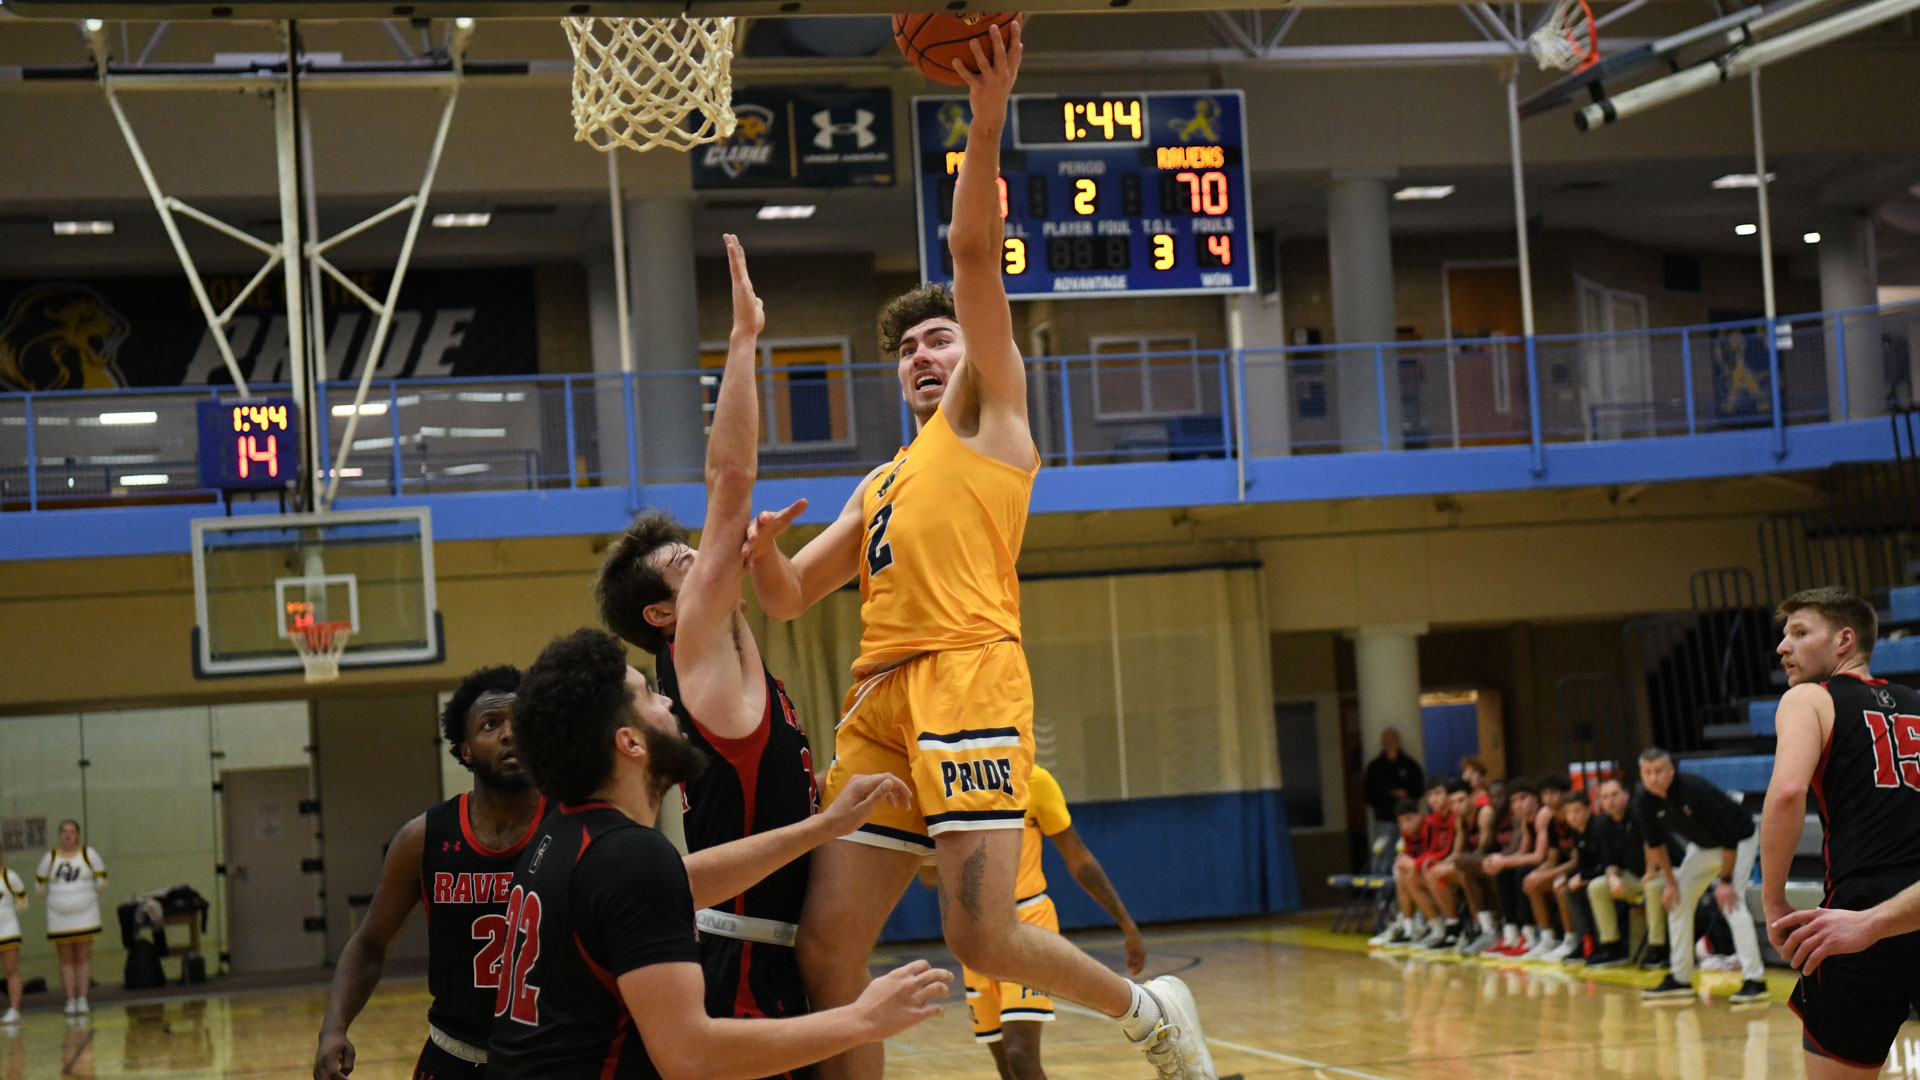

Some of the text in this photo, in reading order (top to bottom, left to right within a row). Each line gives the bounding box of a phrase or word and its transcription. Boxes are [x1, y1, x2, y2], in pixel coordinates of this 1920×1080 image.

[1064, 101, 1142, 140] 1:44
[1059, 161, 1105, 175] PERIOD
[1074, 178, 1097, 215] 2
[1176, 172, 1229, 215] 70
[1043, 219, 1131, 237] PLAYER FOUL
[1192, 217, 1234, 232] FOULS
[1004, 238, 1026, 274] 3
[1153, 234, 1175, 270] 3
[1208, 235, 1231, 266] 4
[1053, 275, 1127, 292] ADVANTAGE
[1201, 272, 1233, 287] WON
[233, 405, 287, 432] 1:44
[238, 434, 278, 478] 14
[867, 502, 894, 578] 2
[939, 756, 1015, 800] PRIDE
[434, 872, 514, 903] RAVE
